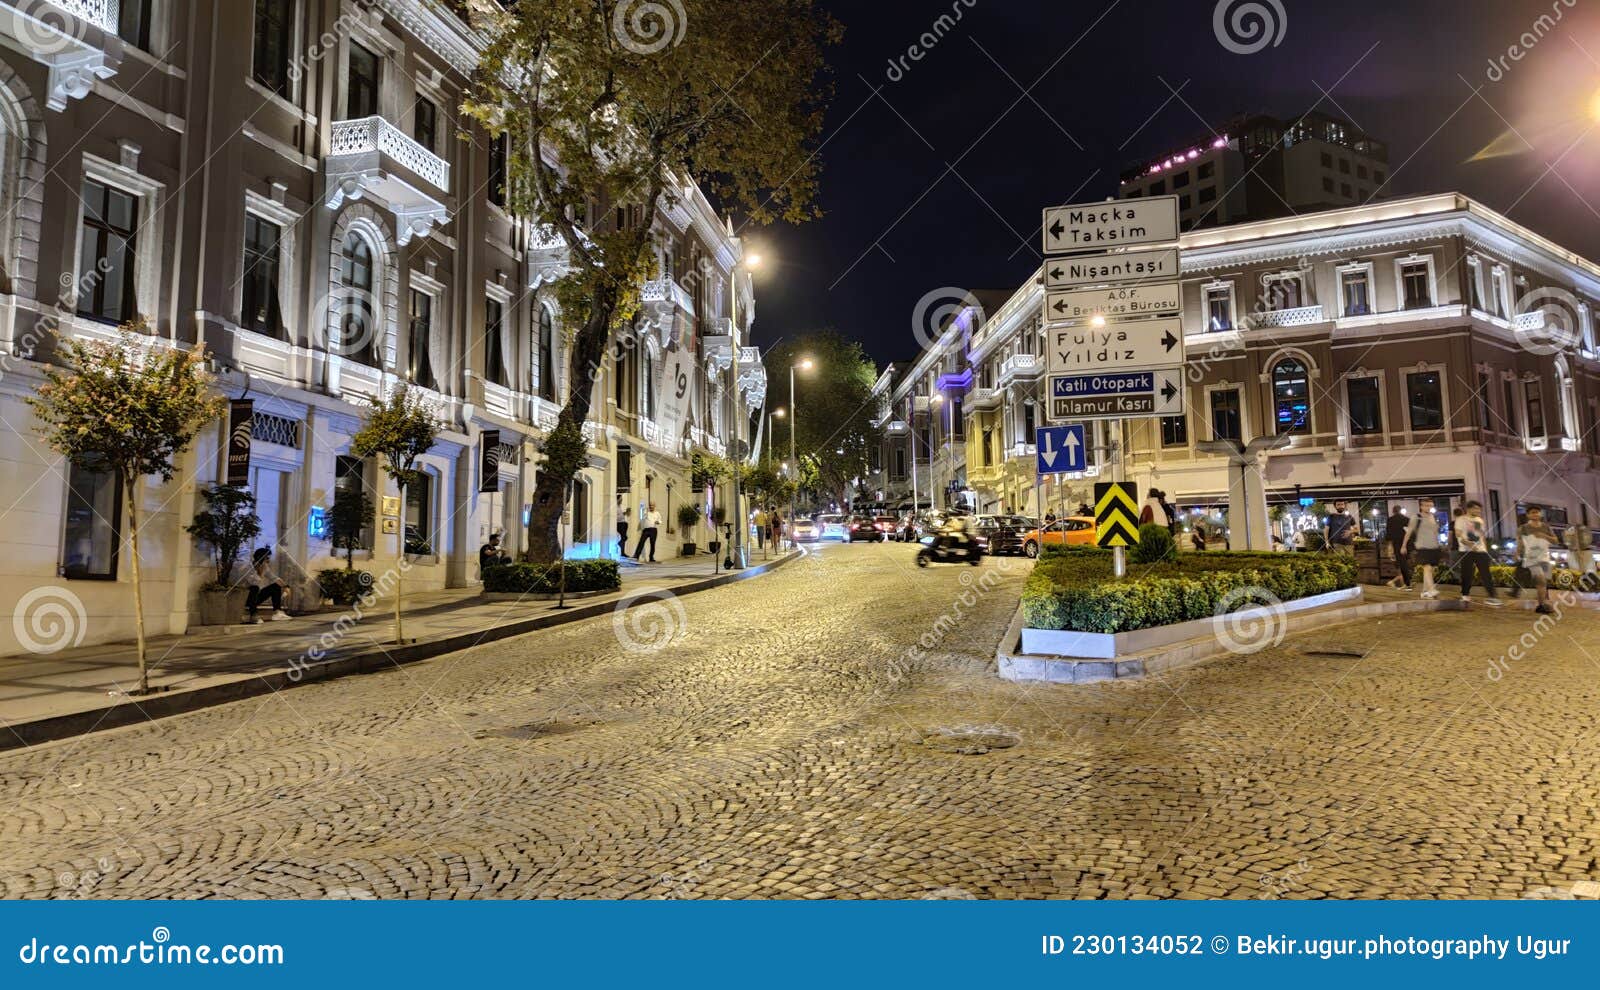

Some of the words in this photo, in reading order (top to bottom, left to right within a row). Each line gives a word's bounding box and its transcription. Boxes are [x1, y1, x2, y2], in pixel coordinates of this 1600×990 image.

[1070, 207, 1136, 224] Maçka
[1071, 226, 1146, 243] Taksim
[1070, 260, 1163, 278] Nişantaşı
[1130, 298, 1176, 311] Bürosu
[1057, 330, 1128, 346] Fulya
[1058, 349, 1135, 364] Yıldız
[1056, 379, 1087, 393] Katlı
[1091, 375, 1150, 392] Otopark
[1116, 396, 1152, 411] Kasrı
